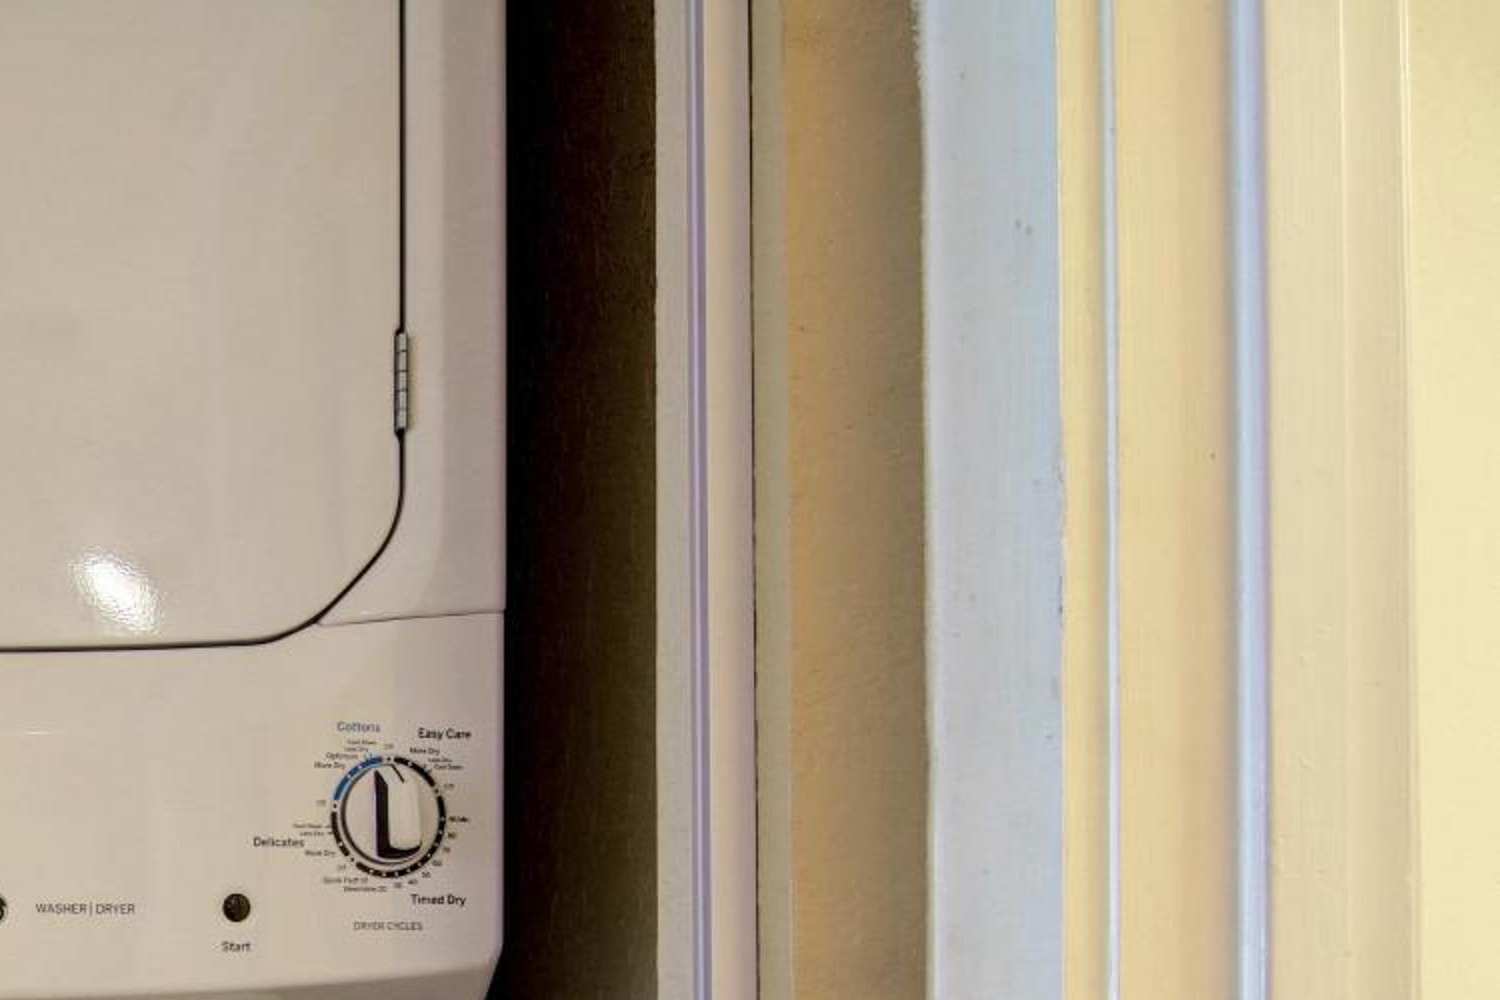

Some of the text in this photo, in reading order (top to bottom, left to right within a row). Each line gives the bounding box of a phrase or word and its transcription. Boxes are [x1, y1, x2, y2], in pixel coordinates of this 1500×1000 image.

[418, 728, 472, 740] Easy Care
[253, 836, 305, 848] Delicates
[411, 894, 467, 908] Timed Dry
[35, 903, 136, 915] WASHER DRYER
[353, 921, 386, 931] DRYER
[221, 941, 252, 952] Start
